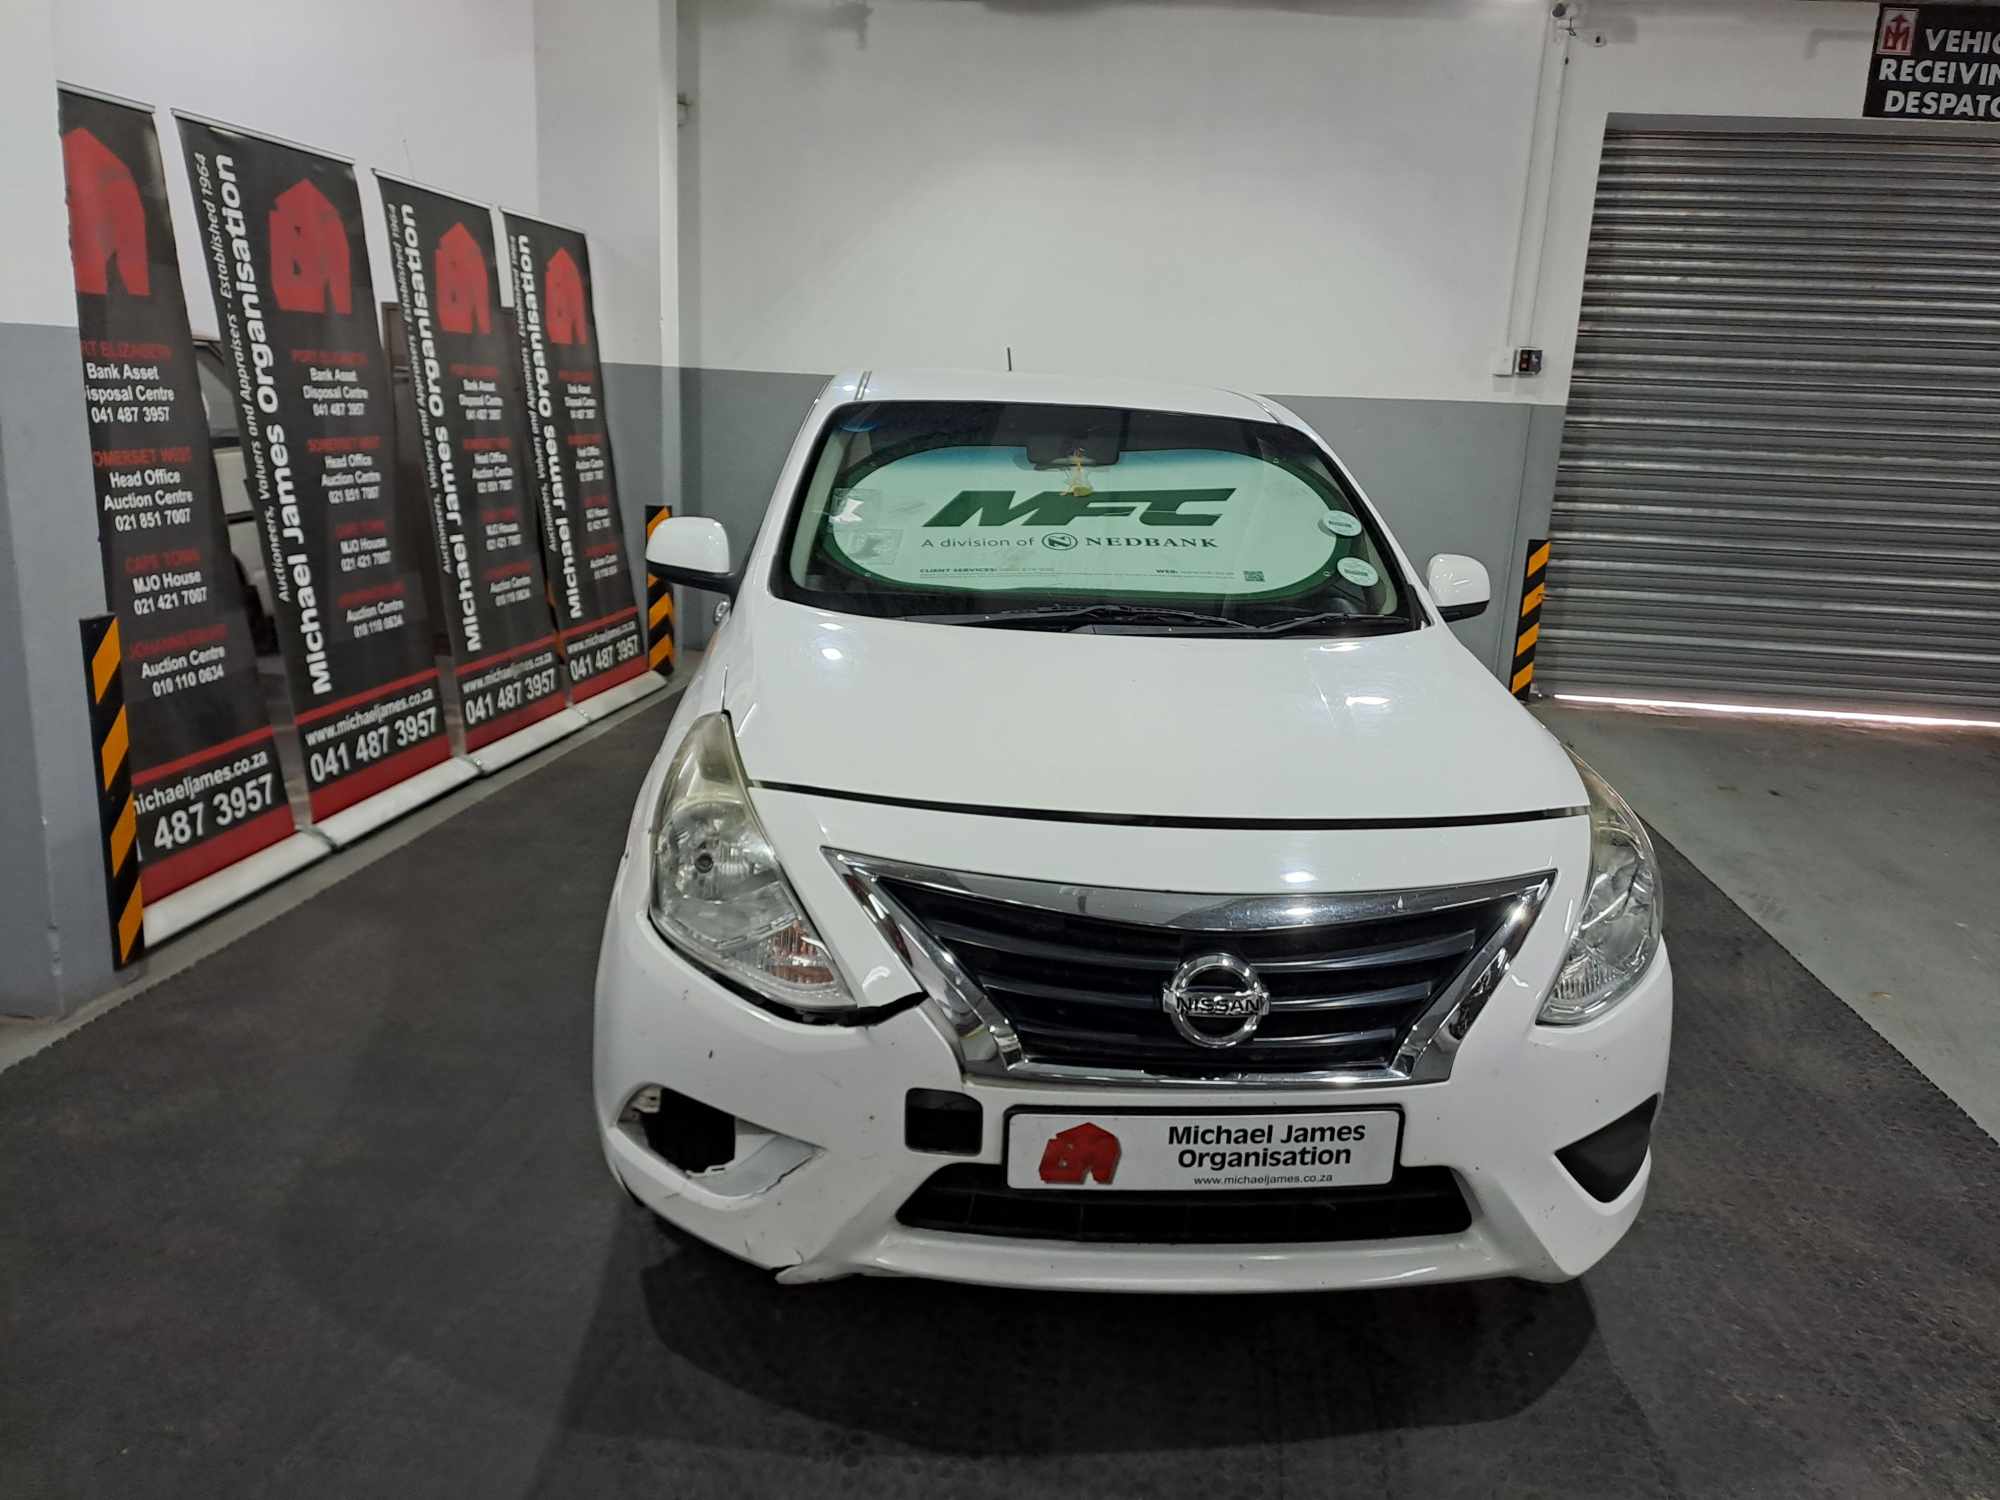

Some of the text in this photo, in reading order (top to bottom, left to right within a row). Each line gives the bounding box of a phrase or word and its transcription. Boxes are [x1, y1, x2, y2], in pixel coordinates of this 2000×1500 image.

[1878, 58, 2000, 86] RECEIVIN
[194, 151, 214, 198] 1964
[201, 198, 233, 300] Established
[86, 362, 159, 381] Bank Asset
[225, 312, 253, 403] Appraisers
[135, 384, 175, 402] Centre
[91, 405, 171, 424] 041 487 3957
[215, 153, 333, 696] Michael James Organisation
[243, 403, 260, 438] and
[400, 202, 483, 653] Michael James Organisation
[518, 234, 583, 619] Michael James Organisation
[250, 440, 272, 501] Valuers
[348, 452, 373, 467] Office
[109, 467, 181, 489] Head Office
[321, 472, 355, 487] Auction
[104, 489, 194, 511] Auction Centre
[921, 488, 1236, 527] MFC
[115, 512, 137, 532] 021
[140, 509, 162, 529] 851
[921, 536, 1220, 548] A division of NEDBANK
[132, 569, 202, 595] MJO House
[133, 597, 155, 616] 021
[157, 592, 180, 612] 421
[141, 645, 225, 679] Auction Centre
[569, 634, 639, 681] 041 487 3957
[152, 677, 174, 698] 010
[175, 670, 197, 691] 110
[464, 667, 556, 725] 041 487 3957
[304, 687, 435, 747] www.michaeljames.co.za
[310, 705, 438, 783] 041 487 3957
[153, 800, 206, 850] 487
[212, 772, 274, 827] 3957
[1176, 996, 1261, 1014] NISSAN
[1168, 1123, 1367, 1145] Michael James
[1177, 1146, 1353, 1170] Organisation
[1193, 1173, 1334, 1186] www.michaeljames.co.za
